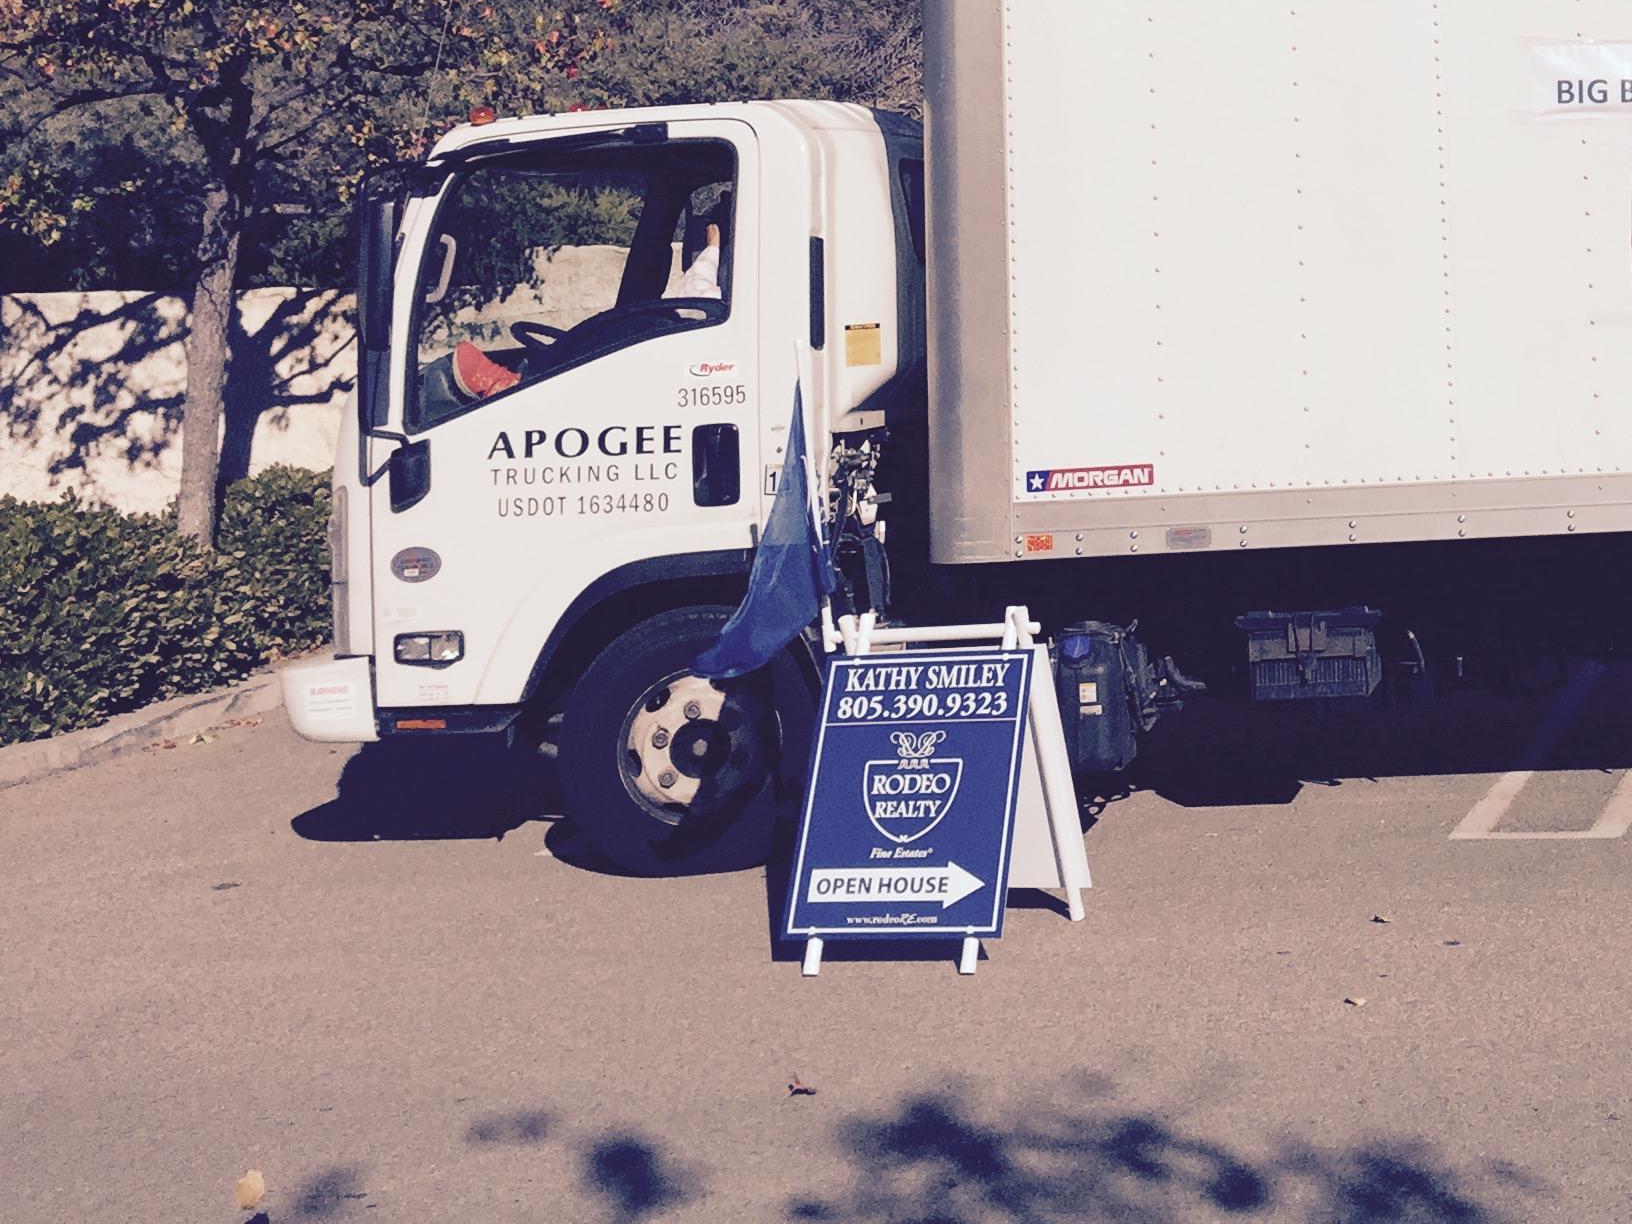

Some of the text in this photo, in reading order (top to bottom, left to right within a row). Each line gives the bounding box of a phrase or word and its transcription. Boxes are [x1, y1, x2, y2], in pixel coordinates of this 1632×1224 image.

[1557, 79, 1608, 104] BIG
[699, 362, 736, 375] Ryder
[678, 385, 746, 408] 316595
[487, 425, 682, 460] APOGEE
[490, 462, 678, 486] TRUCKING LLC
[1050, 468, 1150, 488] MORGAN
[498, 492, 670, 517] USDOT 1634480
[845, 663, 1010, 692] KATHY SMILEY
[837, 692, 1008, 720] 805.390.9323
[871, 774, 950, 795] RODEO
[874, 800, 942, 819] REALTY
[869, 847, 893, 859] Fine
[816, 876, 949, 895] OPEN HOUSE
